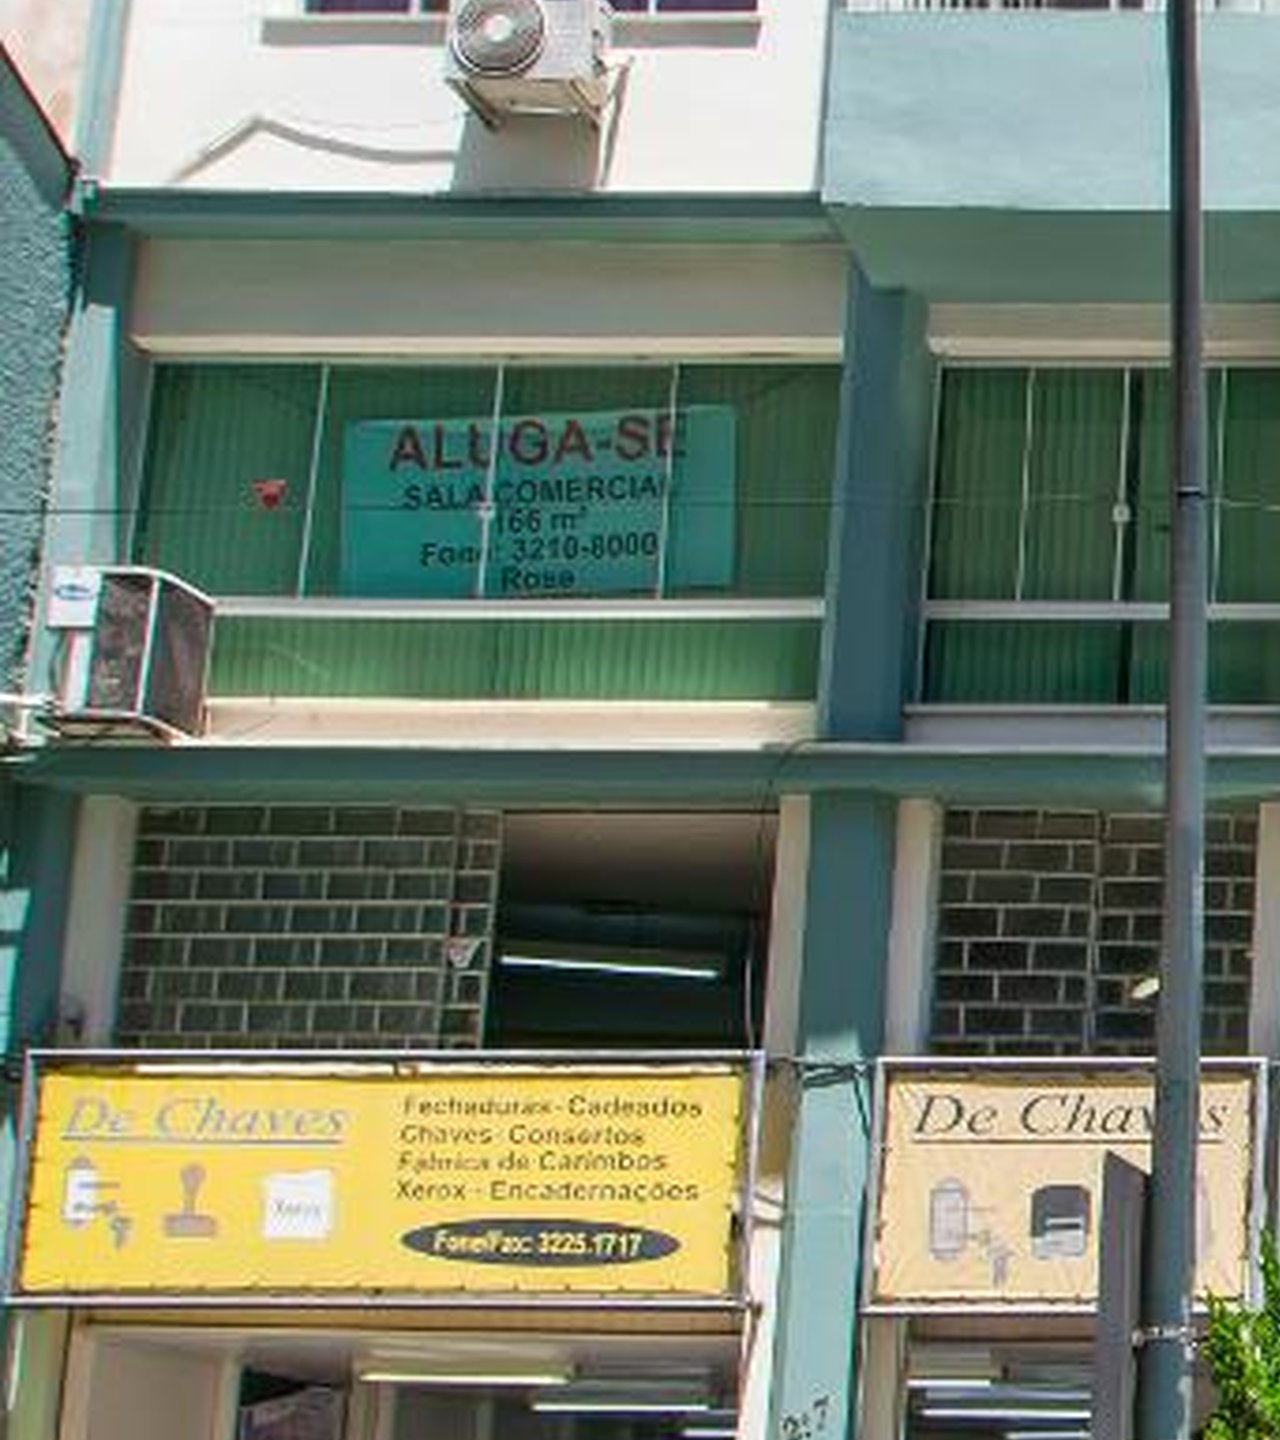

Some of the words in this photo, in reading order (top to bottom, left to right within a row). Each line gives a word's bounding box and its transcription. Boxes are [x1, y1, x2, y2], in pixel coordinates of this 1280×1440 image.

[389, 412, 687, 472] ALUGA-SE
[403, 484, 486, 512] SALA
[155, 1095, 349, 1138] Chaves
[567, 1094, 704, 1119] Cadeados
[913, 1093, 1000, 1136] De
[1020, 1092, 1230, 1136] Chavs
[538, 1151, 668, 1172] Carimbos
[396, 1180, 468, 1202] Xerox
